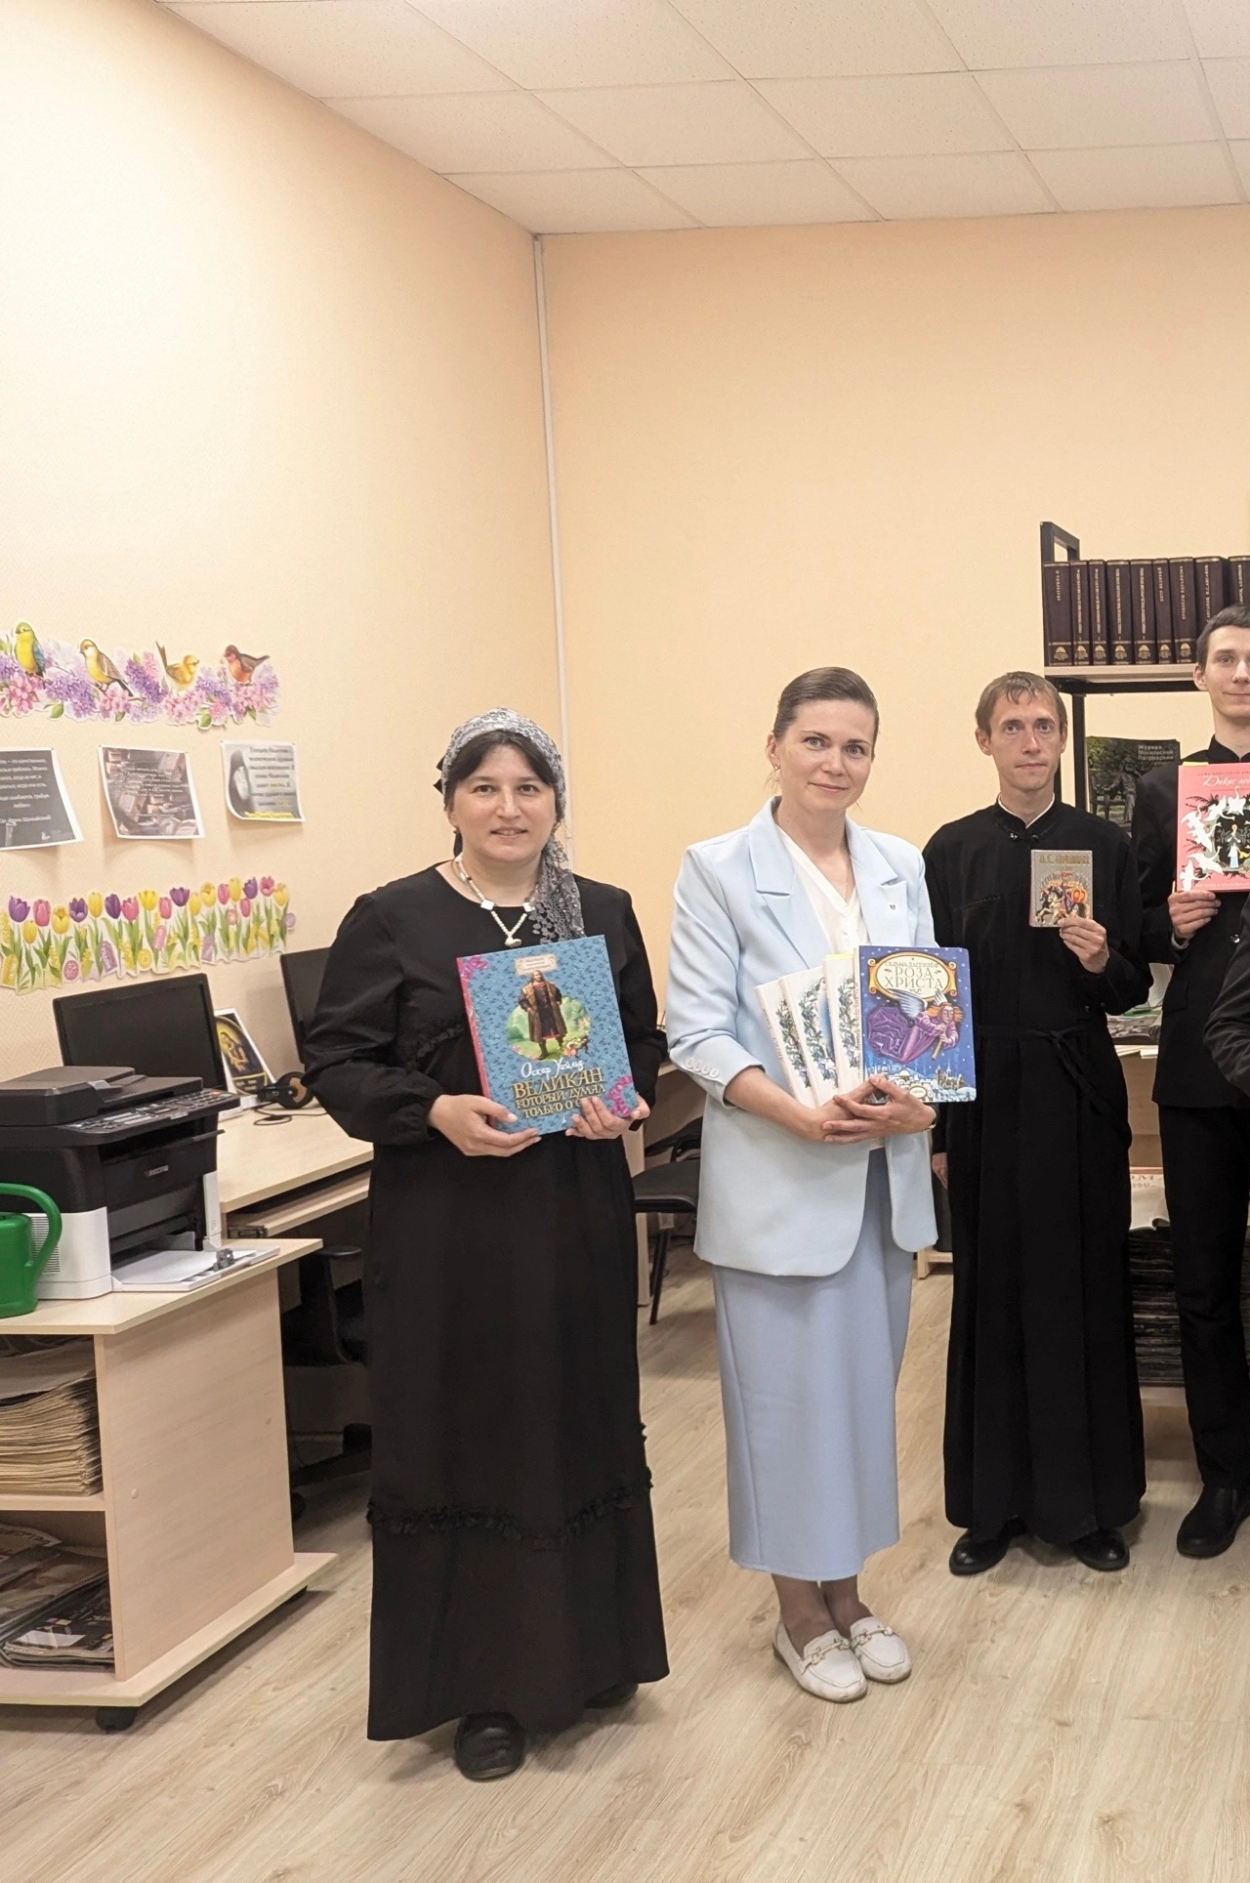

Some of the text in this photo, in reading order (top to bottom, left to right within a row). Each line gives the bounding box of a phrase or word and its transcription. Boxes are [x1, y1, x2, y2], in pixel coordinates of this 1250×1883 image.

[895, 966, 934, 981] РОЗА
[884, 976, 943, 989] ХРИСТА
[521, 1062, 551, 1080] Оскар
[512, 1067, 604, 1098] ВЕЛИКАН
[516, 1091, 564, 1109] КОТОРЫЙ
[569, 1084, 606, 1099] ДУМАЛ
[523, 1103, 563, 1118] ТОЛЬКО
